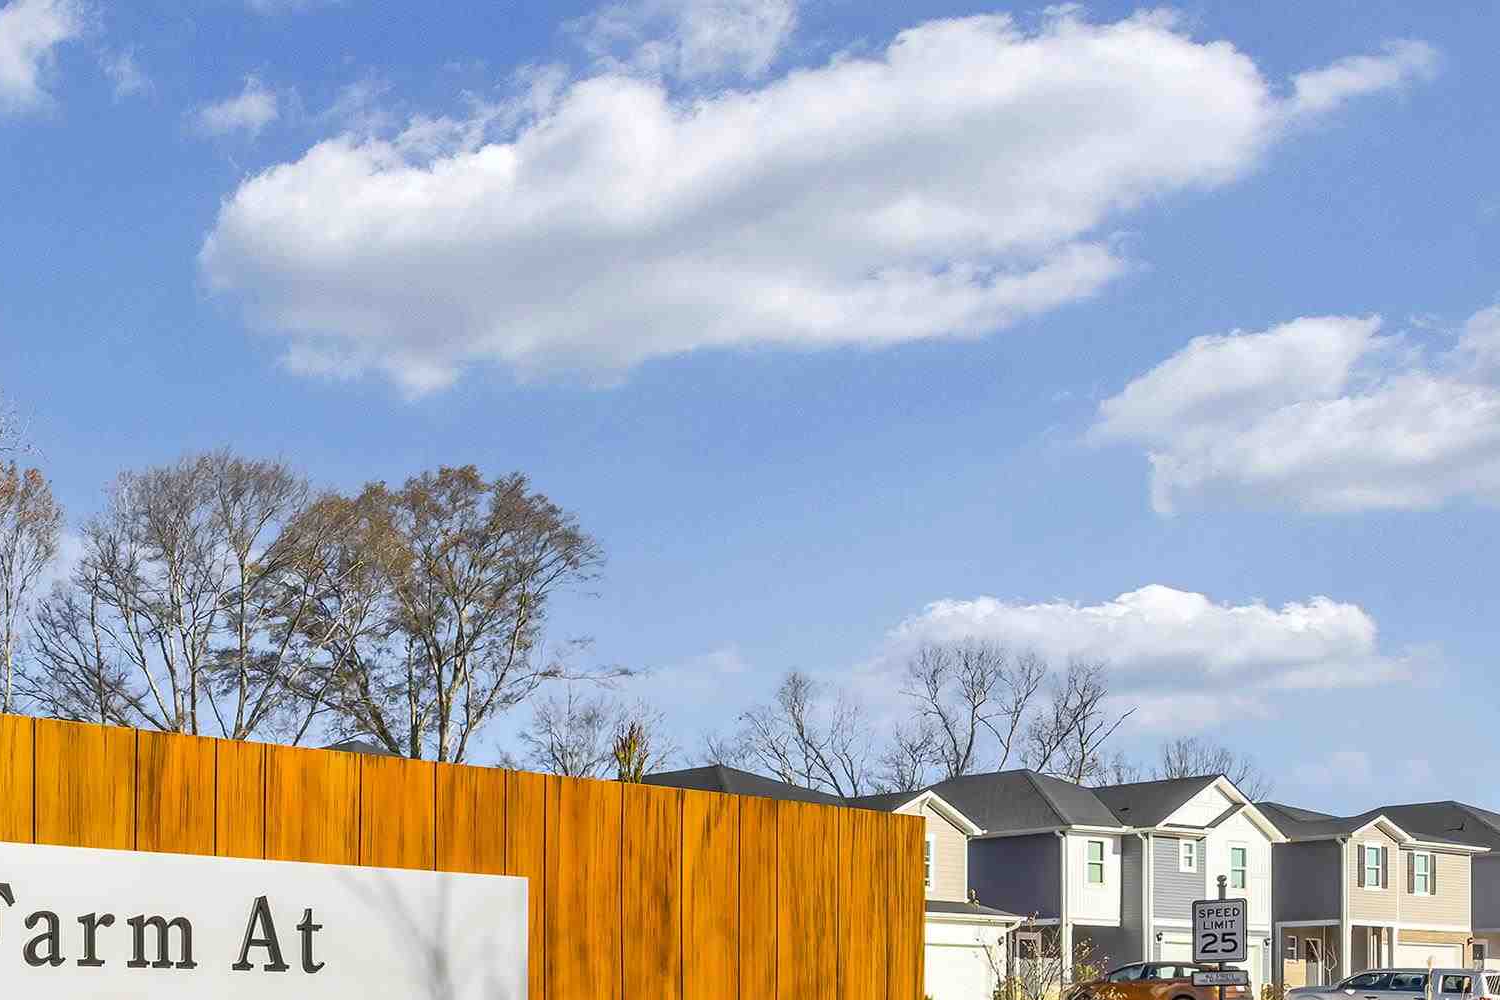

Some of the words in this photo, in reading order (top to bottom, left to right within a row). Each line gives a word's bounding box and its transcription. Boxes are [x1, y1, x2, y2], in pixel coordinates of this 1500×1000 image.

[1199, 907, 1240, 918] SPEED
[1203, 919, 1236, 930] LIMIT
[232, 895, 325, 974] At
[1200, 932, 1238, 954] 25
